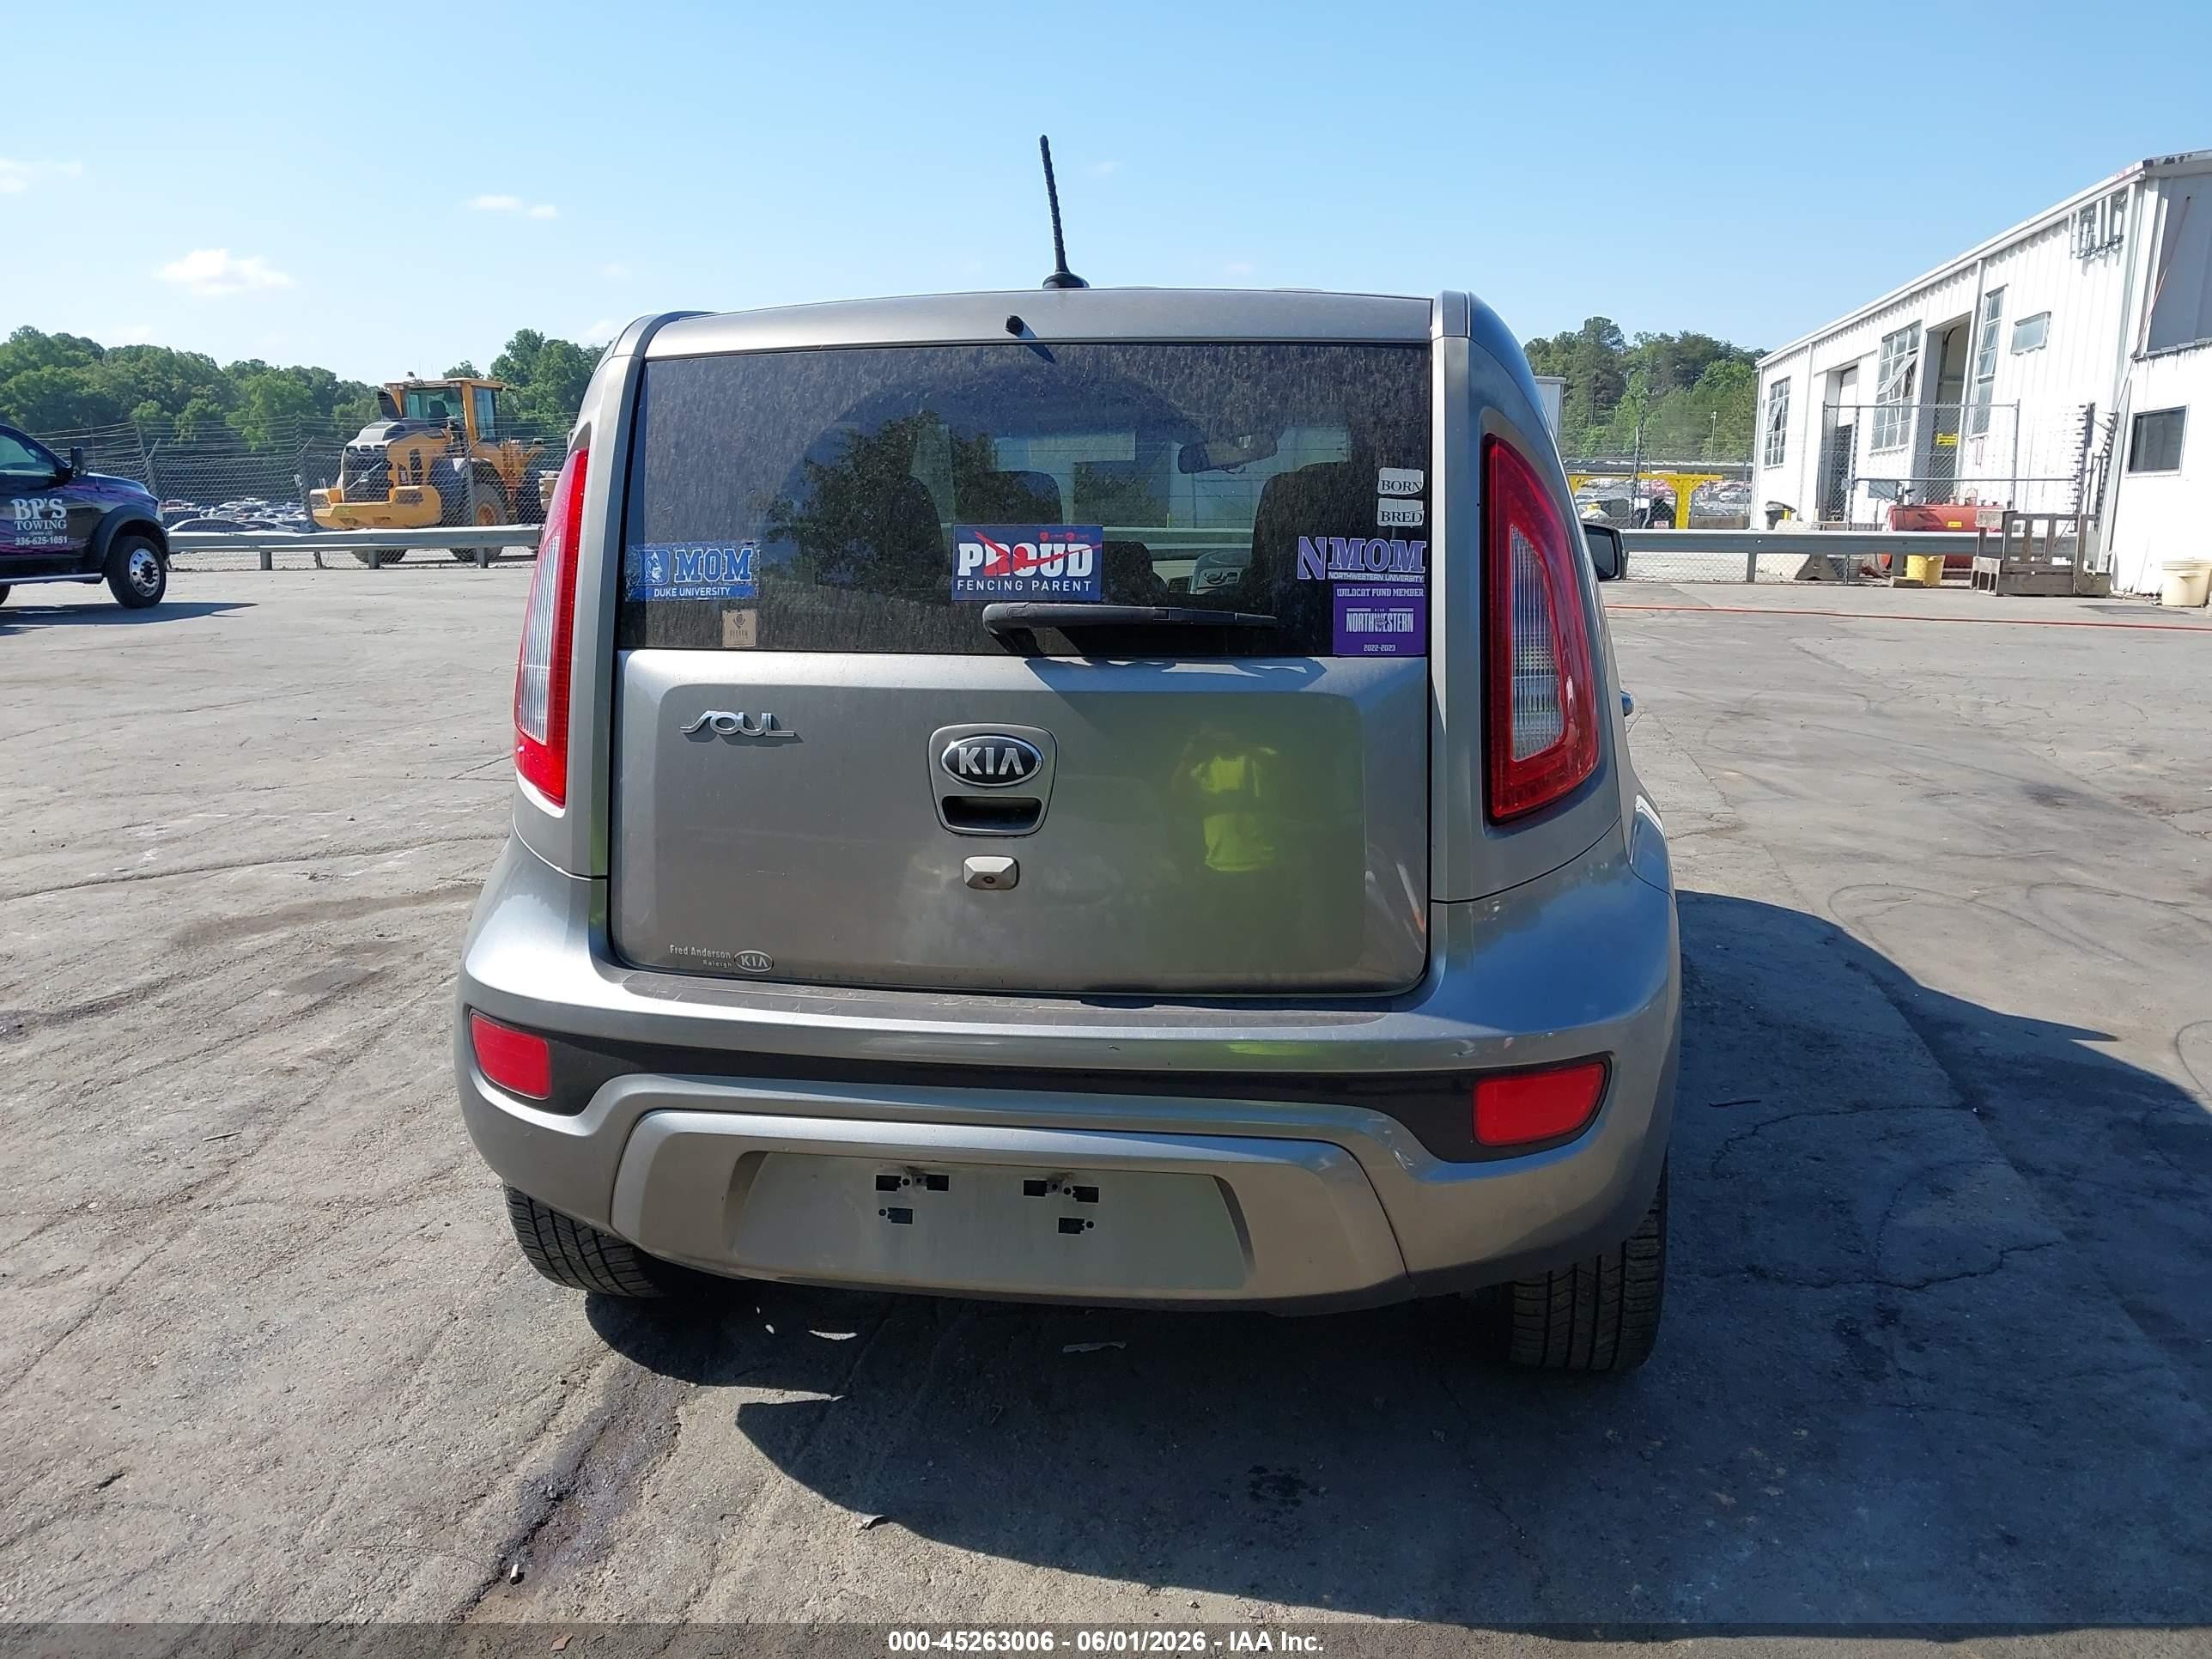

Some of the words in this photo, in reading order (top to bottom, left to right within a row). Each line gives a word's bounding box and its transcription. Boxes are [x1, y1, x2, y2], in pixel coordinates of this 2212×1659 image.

[1381, 480, 1422, 492] BORN
[10, 498, 67, 520] BP'S
[1380, 511, 1422, 522] BRED
[14, 520, 67, 530] TOWING
[1328, 537, 1426, 573] MOM
[674, 548, 753, 583] MOM
[1328, 571, 1383, 581] NORTHWESTERN
[1385, 574, 1425, 583] UNIVERSITY
[654, 588, 677, 597] DUKE
[679, 586, 731, 597] UNIVERSITY
[957, 580, 1024, 591] FENCING
[1031, 580, 1091, 592] PARENT
[1336, 588, 1370, 597] WILDCAT
[1371, 588, 1392, 597] FUND
[1393, 588, 1424, 597] MEMBER
[958, 747, 1024, 775] KIA
[670, 945, 688, 956] Fred
[690, 946, 731, 959] Anderson
[740, 955, 769, 968] KIA
